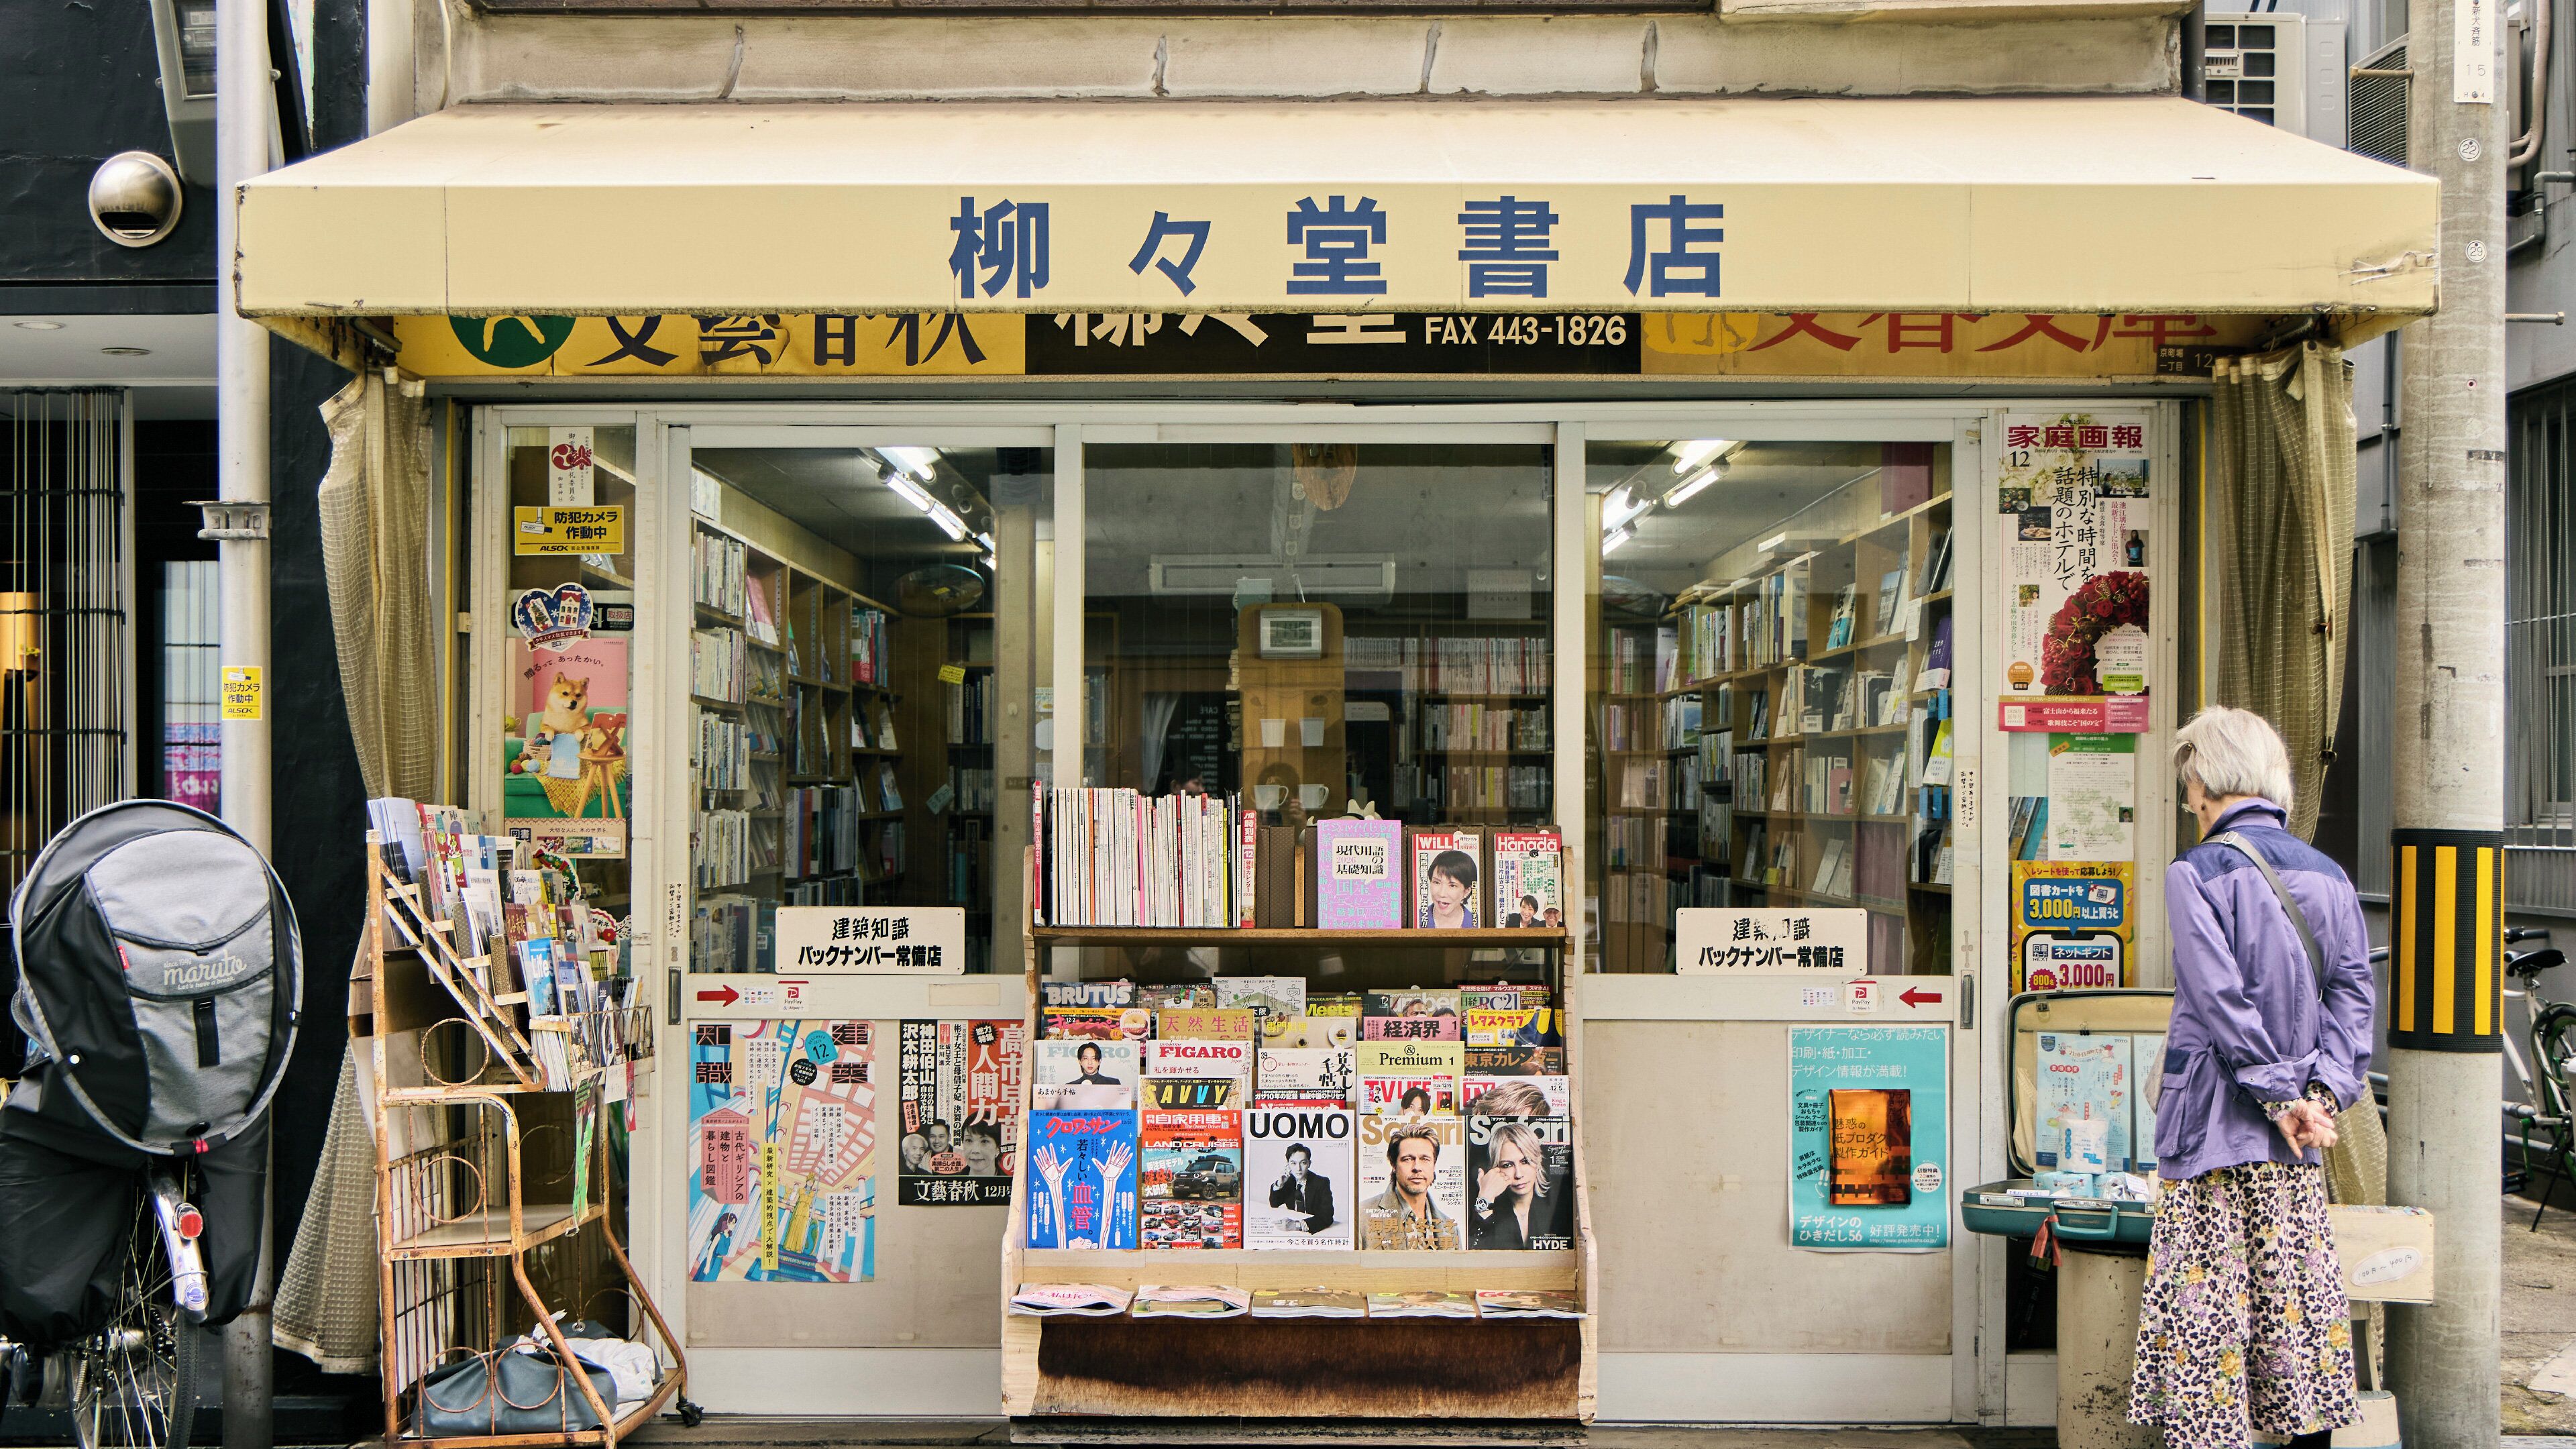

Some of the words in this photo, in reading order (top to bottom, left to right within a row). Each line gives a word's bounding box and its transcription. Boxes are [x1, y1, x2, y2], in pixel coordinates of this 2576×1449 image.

[2466, 64, 2487, 77] 15
[2461, 144, 2477, 156] 22
[948, 195, 1724, 299] 柳々堂書店
[2469, 246, 2484, 258] 29
[1426, 315, 1477, 345] FAX
[1488, 315, 1626, 346] 443-1826
[2159, 362, 2183, 372] 一丁目
[2195, 354, 2213, 368] 12
[2008, 425, 2143, 448] 家庭画報
[2010, 451, 2030, 467] 12
[554, 511, 618, 524] 防犯カメラ
[2053, 466, 2076, 590] 話題のホテルで
[2076, 467, 2098, 584] 特別な時間を
[566, 526, 607, 539] 作動中
[2111, 501, 2119, 566] 最新モードに出会う
[608, 610, 633, 621] 取扱店
[223, 683, 260, 692] 防犯カメラ
[228, 694, 253, 703] 作動中
[2043, 707, 2098, 715] 富士山から福来たる
[1419, 837, 1453, 849] WiLL
[1498, 836, 1558, 851] Hanada
[1244, 850, 1254, 859] 12
[1336, 845, 1384, 856] 現代用語
[1336, 856, 1356, 864] 2026
[1372, 856, 1384, 864] の
[1336, 864, 1384, 875] 基礎知識
[2031, 867, 2116, 876] レシートを使って応募しよう!
[2029, 884, 2084, 896] 図書カードを
[833, 916, 909, 941] 建築知識
[798, 945, 942, 967] バックナンバー常備店
[1699, 945, 1843, 968] バックナンバー常備店
[2054, 947, 2110, 958] ネットギフト
[164, 949, 248, 985] maruto
[2059, 964, 2114, 989] 3,000円
[1045, 984, 1132, 1005] BRUTUS
[1164, 1015, 1249, 1033] 天然生活
[1452, 1020, 1457, 1030] 1
[1470, 1014, 1527, 1027] レタスクラブ
[1383, 1020, 1441, 1038] 経済界
[812, 1043, 829, 1060] 12
[919, 1024, 935, 1085] 神田伯山
[1159, 1046, 1242, 1059] FIGARO
[1260, 1051, 1268, 1060] 39
[1404, 1044, 1415, 1056] &
[902, 1024, 919, 1101] 沢木耕太郎
[953, 1024, 962, 1102] 彬子女王と母信子妃
[1379, 1053, 1443, 1065] Premium
[1449, 1057, 1454, 1065] 1
[1464, 1051, 1558, 1067] 東京カレンダー
[1154, 1066, 1199, 1074] 私を輝かせる
[1792, 1064, 1908, 1078] デザイン情報が満載!
[970, 1044, 1000, 1126] 人間力
[1038, 1087, 1076, 1096] あまから手帖
[1145, 1085, 1228, 1104] SAVVY
[1155, 1114, 1222, 1125] 自家用車
[1233, 1112, 1238, 1122] 1
[1835, 1117, 1866, 1130] 魅惑の
[953, 1105, 962, 1146] 決裂の瞬間
[1045, 1116, 1122, 1138] クロワッサン
[1250, 1112, 1349, 1138] UOMO
[719, 1130, 731, 1163] 建物と
[704, 1130, 716, 1186] 暮らし図鑑
[1834, 1148, 1889, 1159] 製作ガイド
[735, 1130, 745, 1201] 古代ギリシアの
[1797, 1157, 1822, 1171] キラキラな
[914, 1180, 979, 1201] 文藝春秋
[1799, 1216, 1862, 1228] デザインの
[1799, 1229, 1863, 1242] ひきだし56
[1870, 1224, 1941, 1238] 好評発売中!
[1533, 1240, 1568, 1250] HYDE
